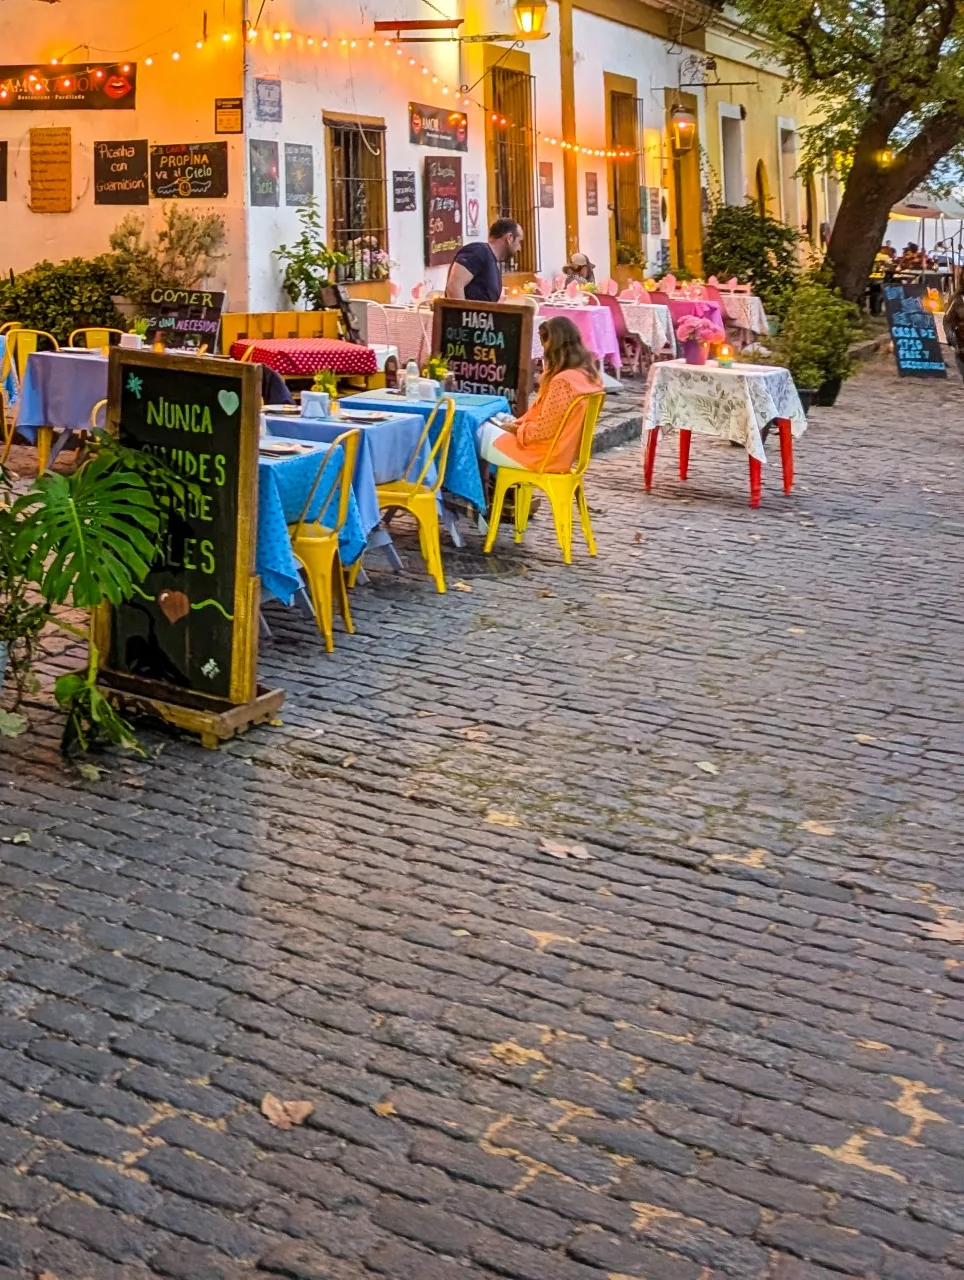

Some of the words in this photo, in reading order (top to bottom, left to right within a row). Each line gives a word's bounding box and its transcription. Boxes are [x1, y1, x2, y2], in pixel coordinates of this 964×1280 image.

[111, 162, 128, 172] con
[159, 152, 209, 168] PROPINA
[155, 170, 168, 180] va
[185, 165, 212, 179] Cielo
[151, 289, 214, 308] COMER
[158, 318, 176, 330] UNA
[462, 311, 495, 331] HAGA
[446, 328, 470, 342] QUE
[473, 329, 505, 349] CADA
[473, 346, 497, 364] SEA
[147, 396, 214, 434] NUNCA
[142, 444, 226, 486] IDES
[149, 534, 216, 574] LES
